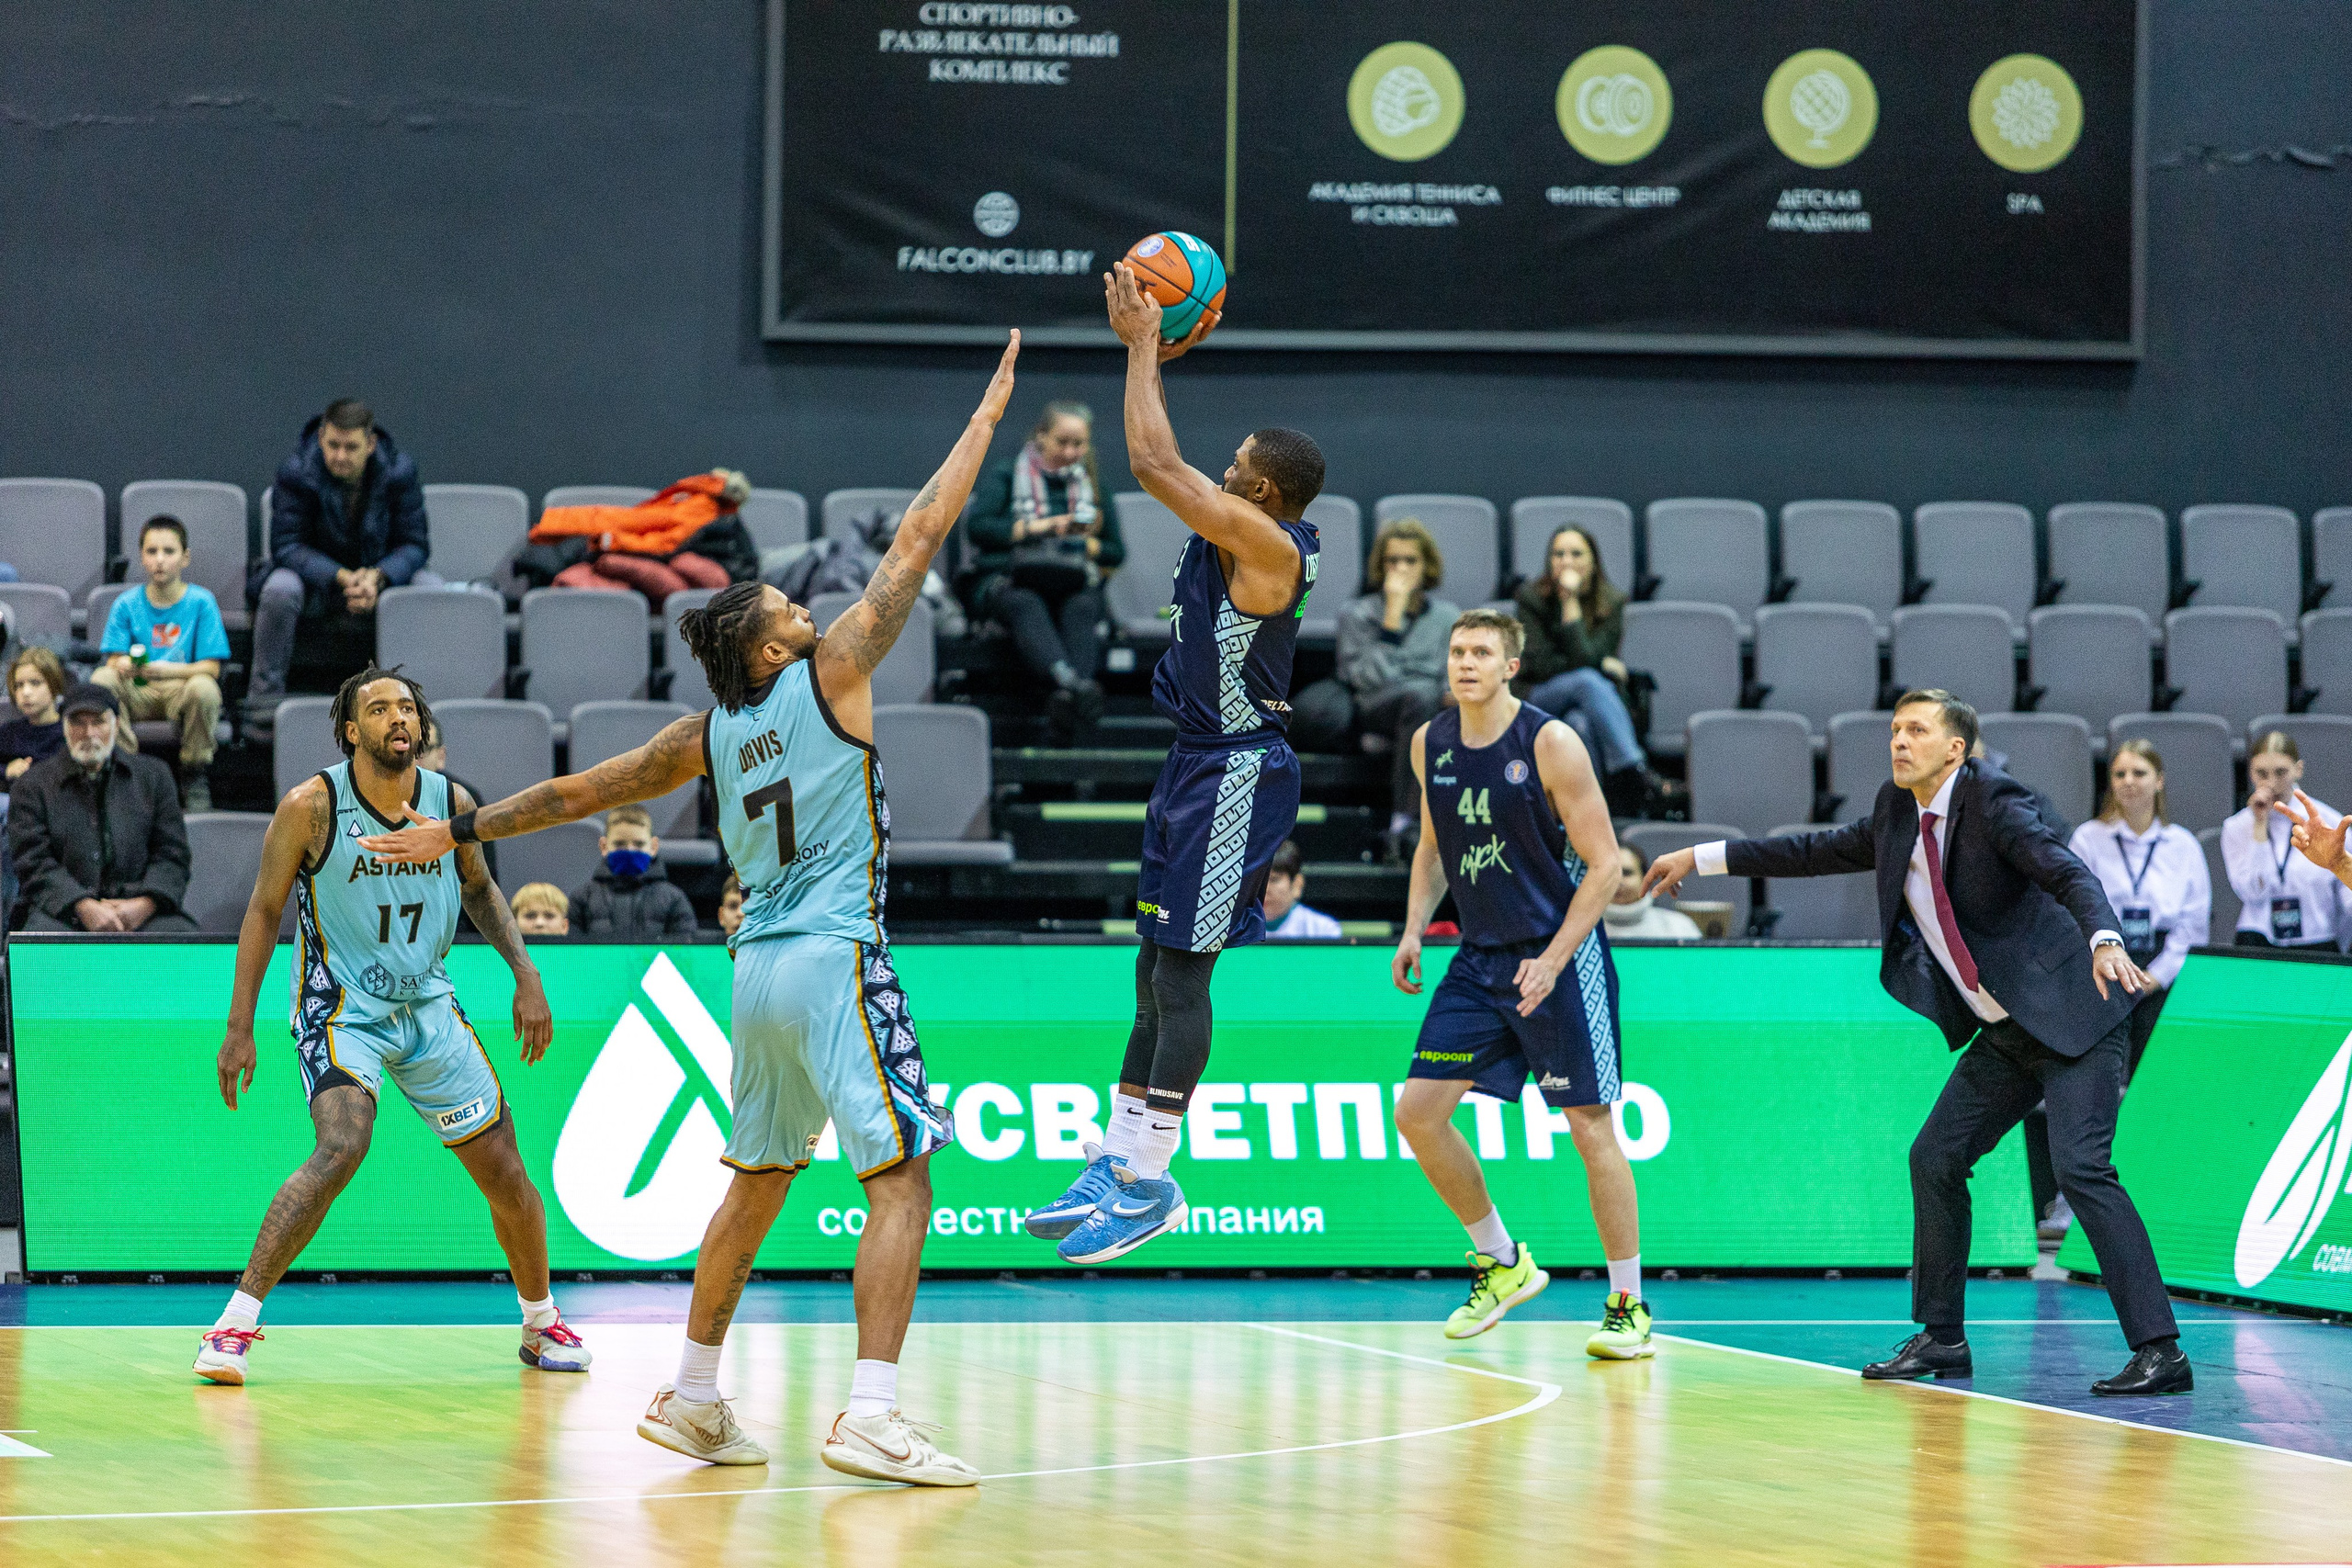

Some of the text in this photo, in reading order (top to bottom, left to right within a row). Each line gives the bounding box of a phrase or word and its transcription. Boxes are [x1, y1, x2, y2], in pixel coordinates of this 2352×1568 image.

[920, 2, 1080, 28] СПОРТИВНО-
[879, 29, 1119, 57] РАЗВЛЕКАТЕЛЬНЫЙ
[929, 59, 1071, 85] КОМПЛЕКС
[898, 246, 1095, 275] FALCONCLUB.BY
[739, 729, 783, 773] DAVIS
[1457, 787, 1492, 824] 44
[742, 776, 796, 867] 7
[378, 902, 424, 943] 17
[1148, 1087, 1184, 1100] BLINDSAVE
[441, 1102, 479, 1126] 1XBET
